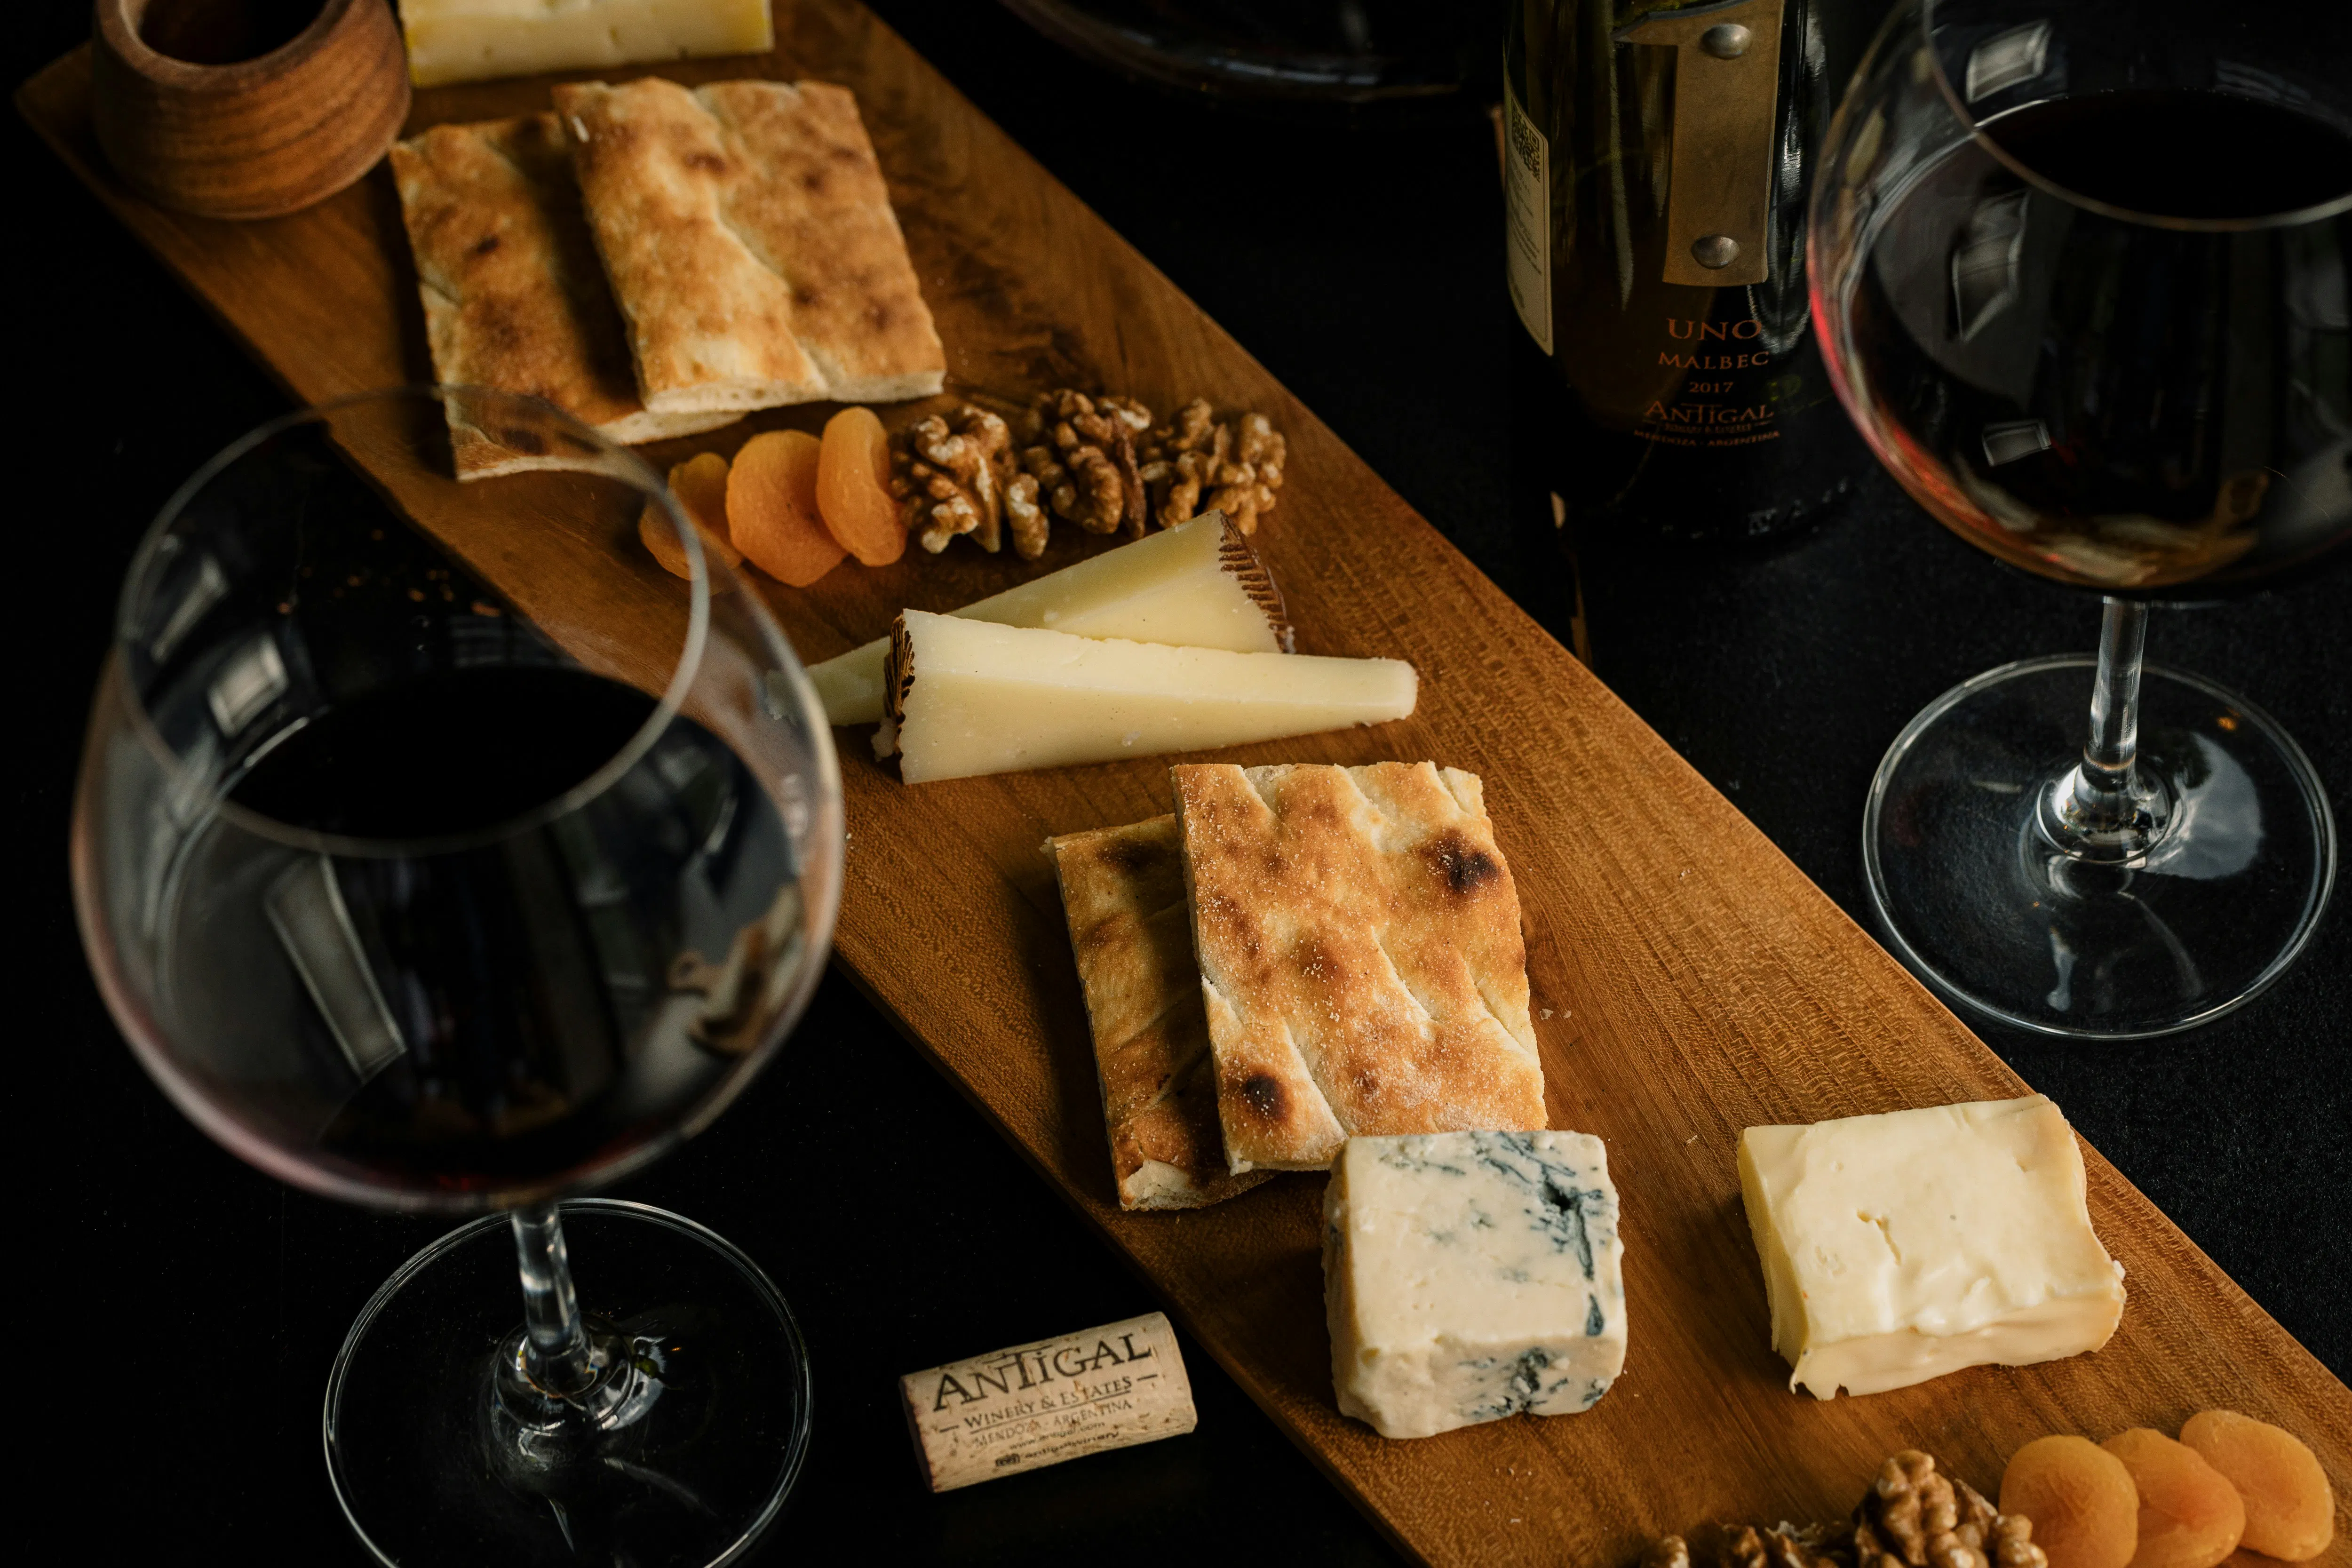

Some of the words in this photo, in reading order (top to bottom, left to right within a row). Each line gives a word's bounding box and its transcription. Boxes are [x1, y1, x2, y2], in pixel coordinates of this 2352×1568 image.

[1667, 318, 1763, 341] UNO
[1658, 351, 1770, 370] MALBEC
[1688, 382, 1734, 394] 2017
[1645, 400, 1775, 424] ANTIGAL
[964, 1401, 1035, 1428] WINERY
[1041, 1396, 1057, 1409] &
